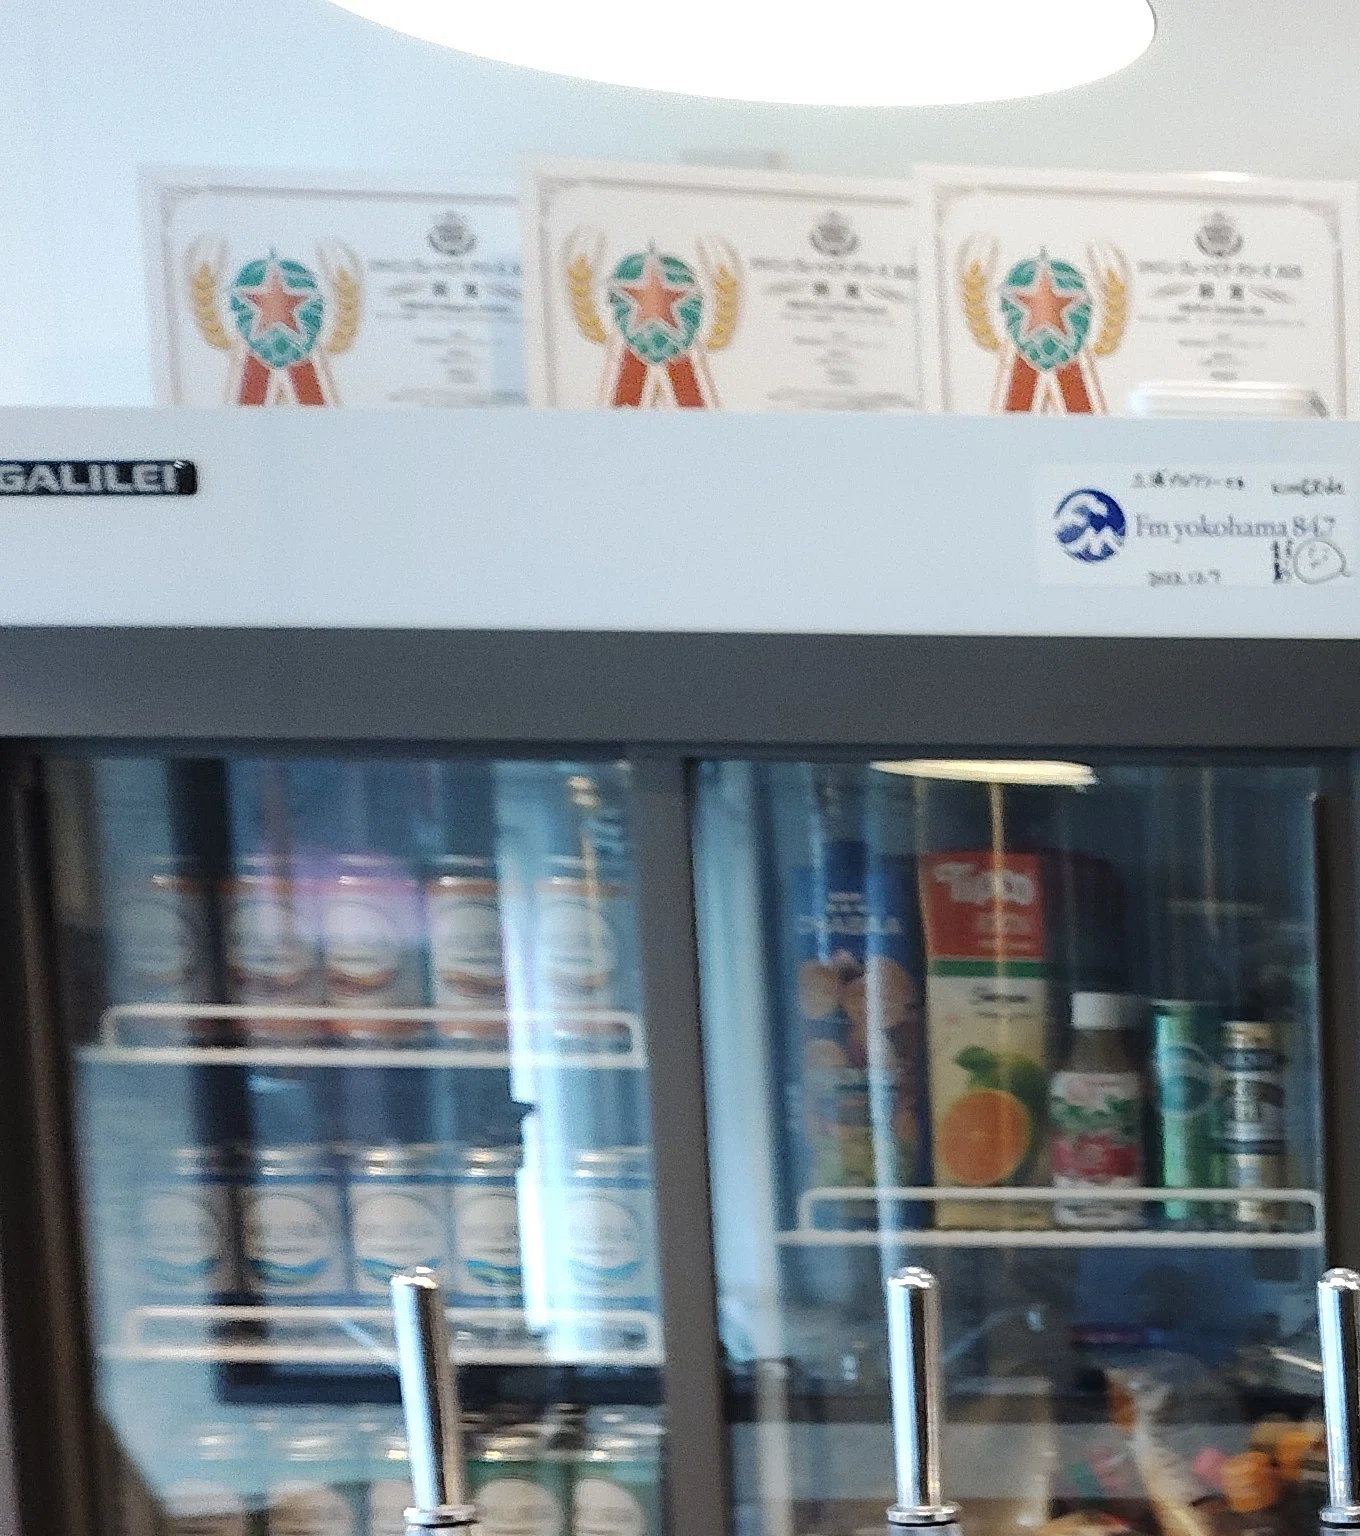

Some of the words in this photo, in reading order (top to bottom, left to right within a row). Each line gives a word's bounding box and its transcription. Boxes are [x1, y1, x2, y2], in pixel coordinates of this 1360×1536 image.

[0, 463, 179, 494] GALILEI
[1135, 512, 1170, 537] Fm
[1174, 513, 1289, 544] yokohama
